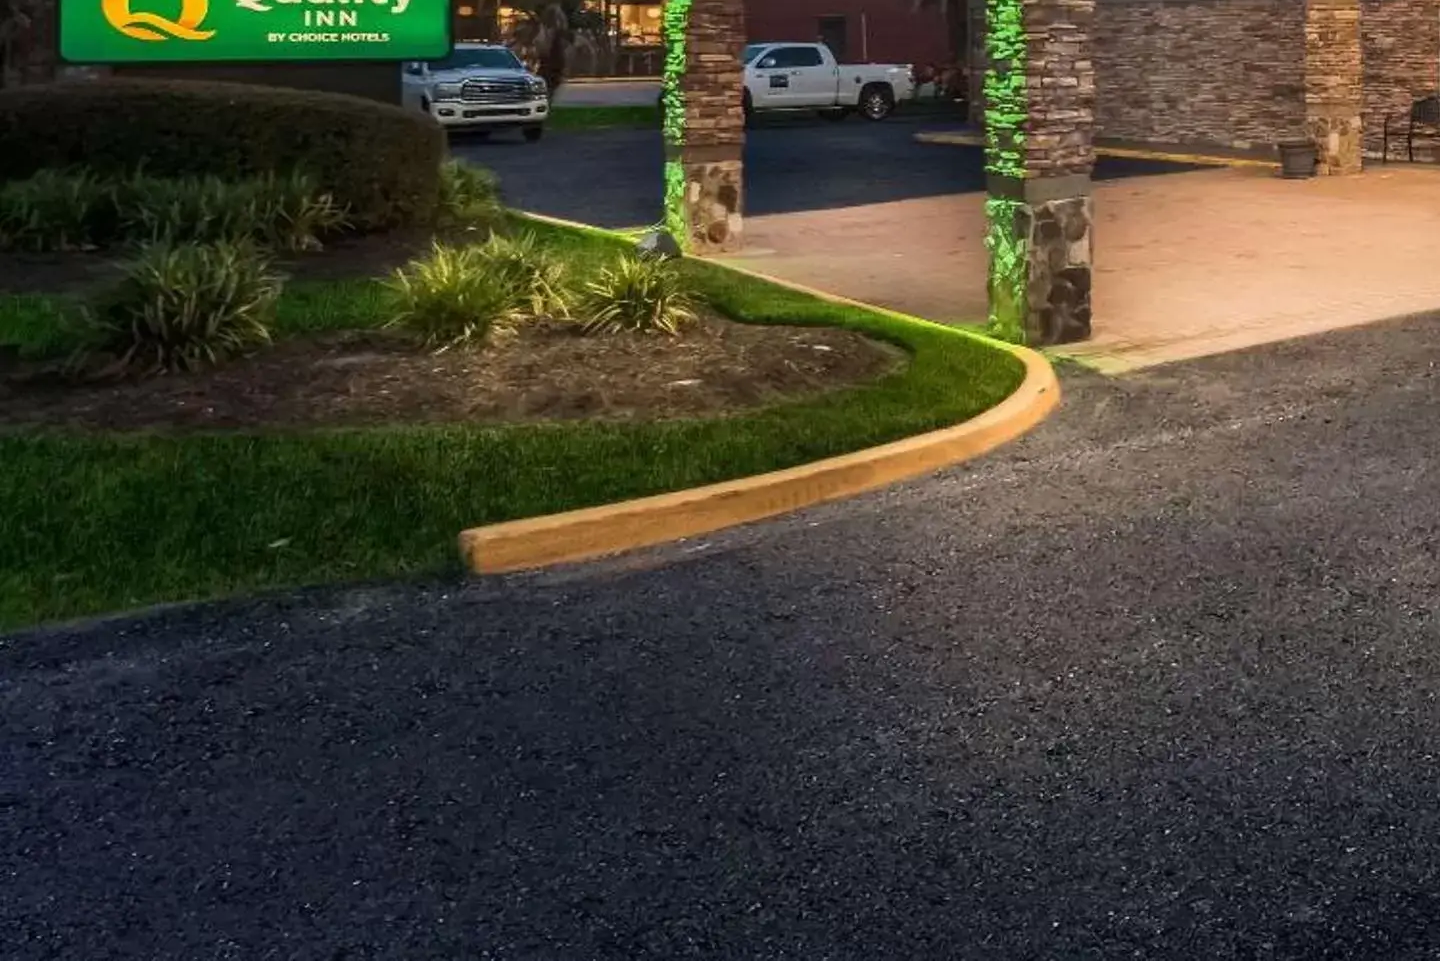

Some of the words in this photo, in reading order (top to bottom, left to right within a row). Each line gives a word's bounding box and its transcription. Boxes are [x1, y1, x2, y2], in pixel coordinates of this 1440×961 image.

[304, 10, 358, 26] INN
[267, 32, 285, 42] BY
[289, 32, 338, 42] CHOICE
[341, 32, 390, 42] HOTELS
